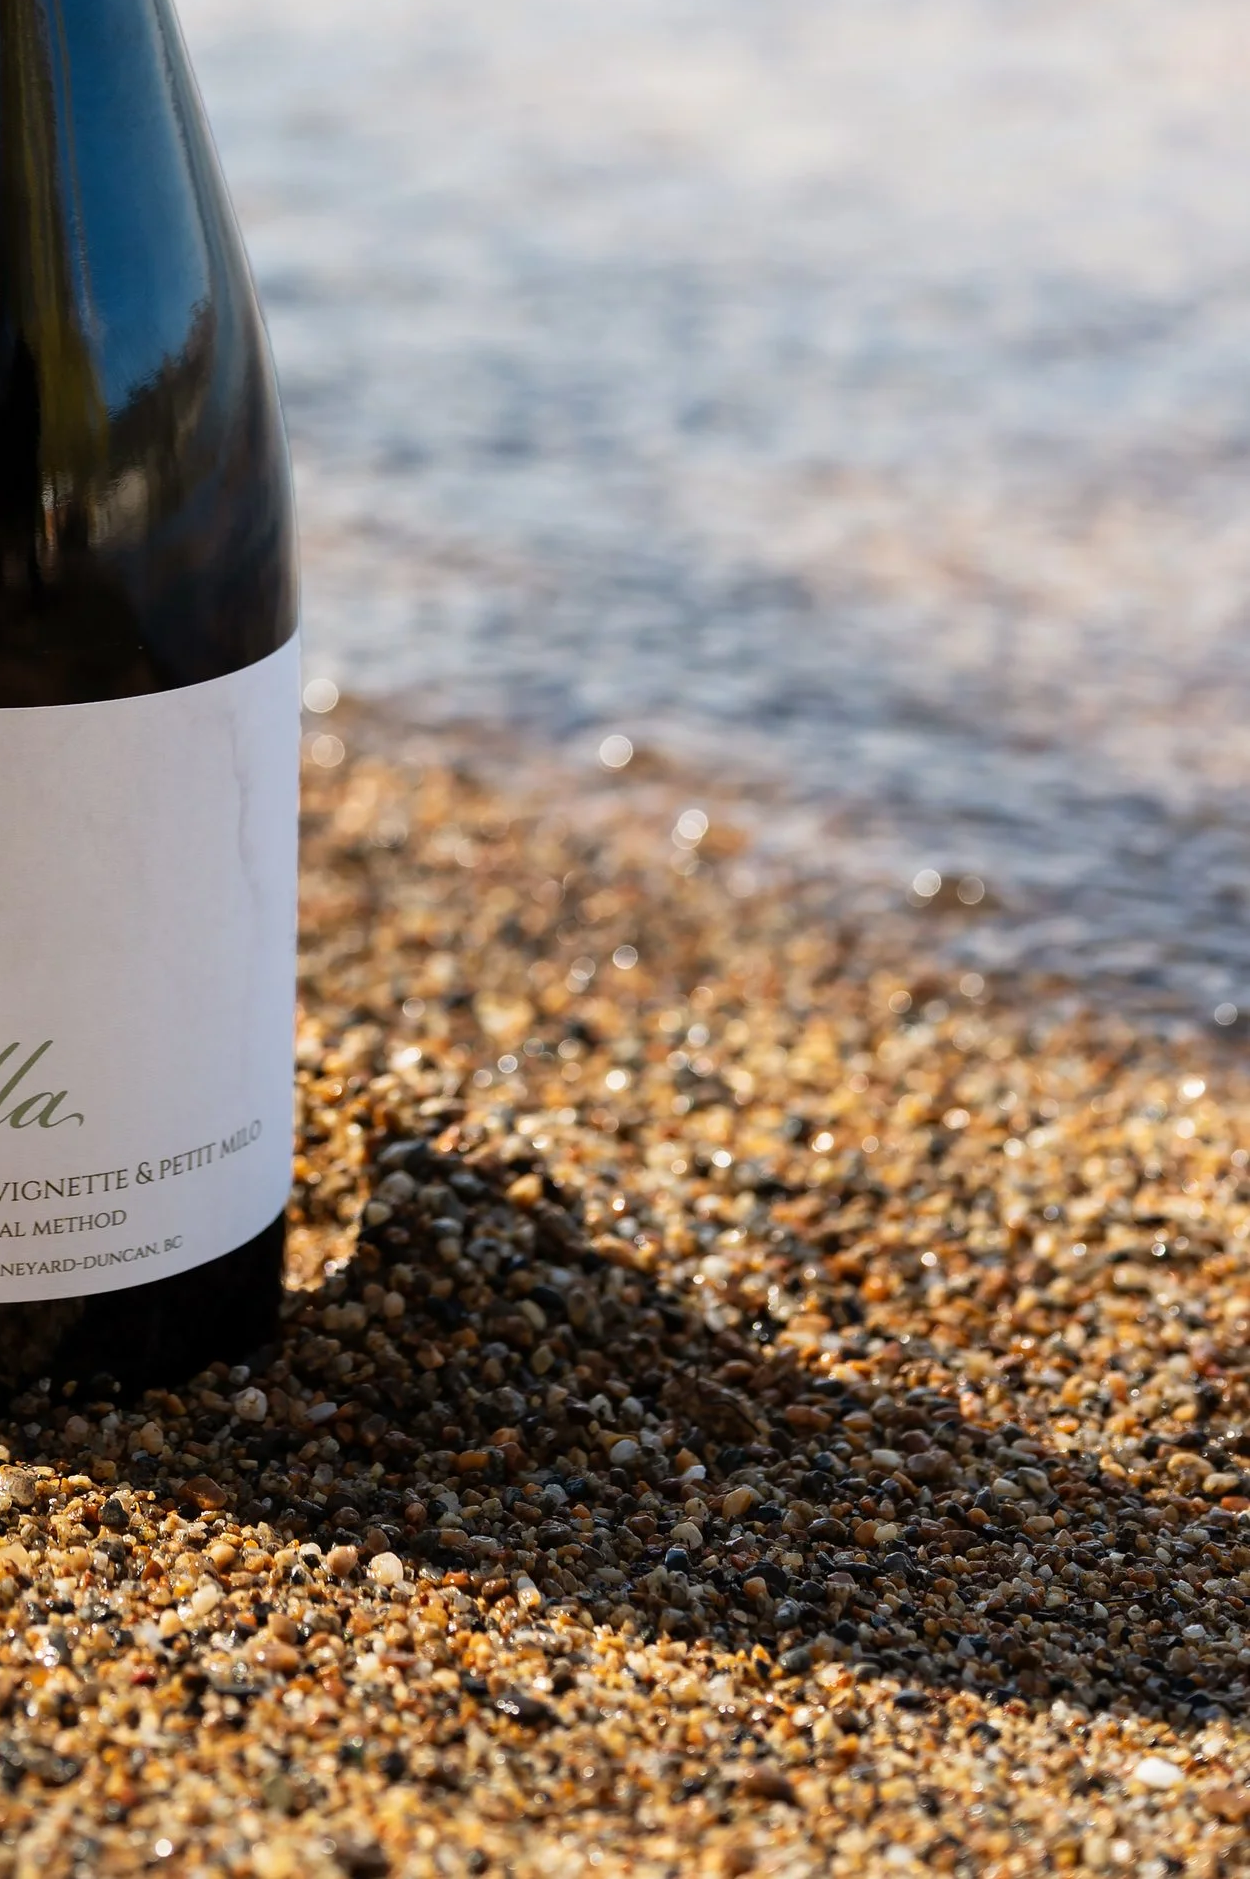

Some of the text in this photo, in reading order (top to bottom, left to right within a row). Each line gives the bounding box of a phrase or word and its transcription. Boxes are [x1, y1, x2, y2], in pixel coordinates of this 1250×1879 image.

[134, 1161, 154, 1186] &
[159, 1141, 218, 1180] PETIT
[219, 1119, 262, 1159] MILO
[31, 1208, 128, 1237] METHOD
[163, 1235, 184, 1252] BC
